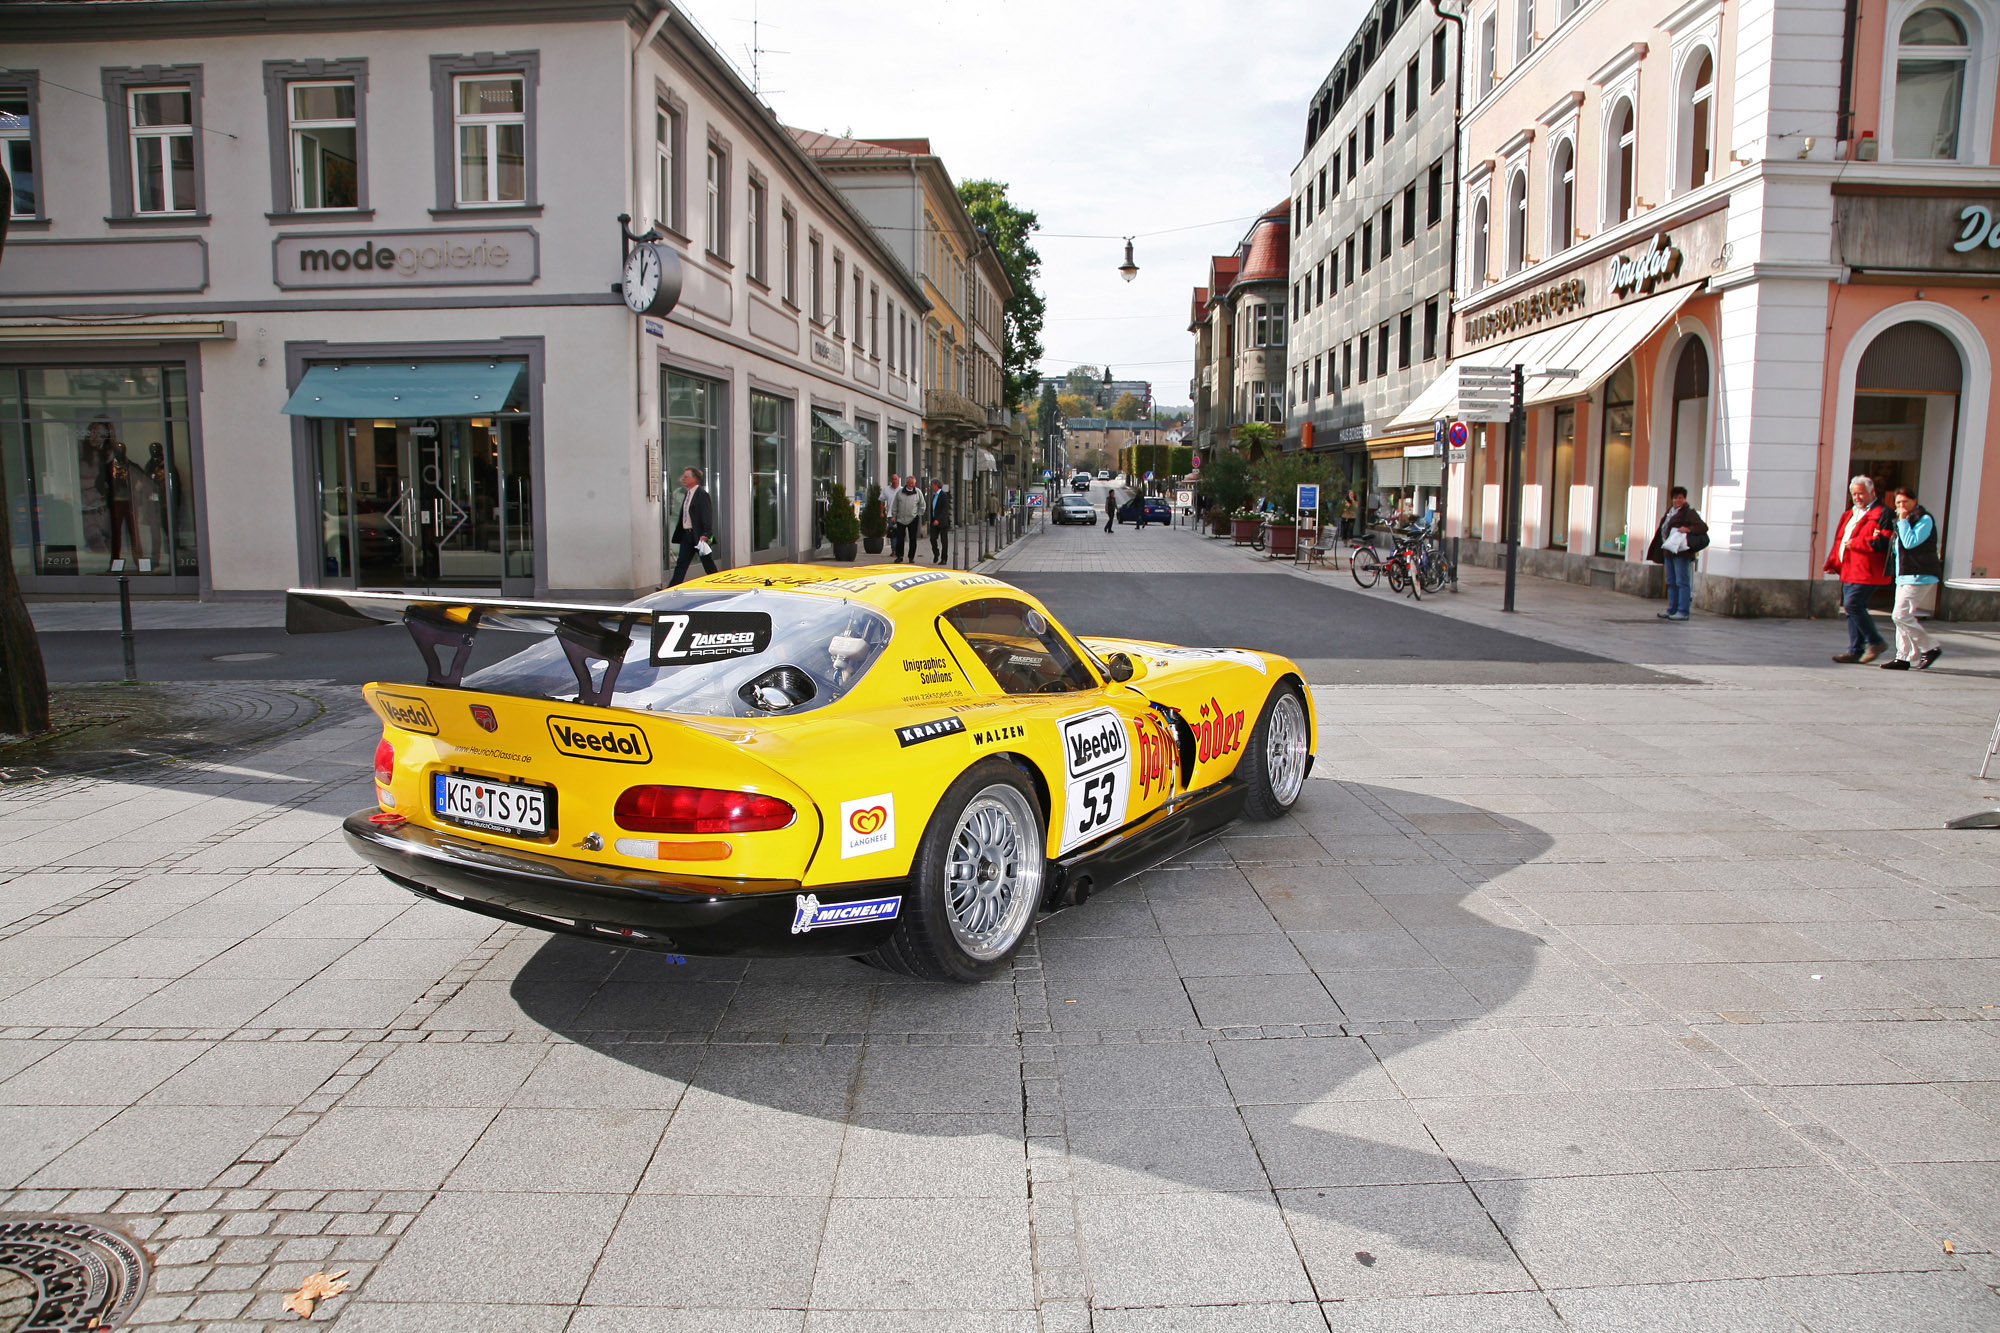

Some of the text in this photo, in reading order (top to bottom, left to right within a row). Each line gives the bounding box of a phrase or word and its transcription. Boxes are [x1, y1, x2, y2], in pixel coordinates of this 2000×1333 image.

[1607, 231, 1674, 294] Douglas
[1464, 278, 1583, 344] HAUS BOXBERGER
[47, 556, 71, 565] zero
[895, 571, 946, 589] KRAFFT
[689, 646, 755, 657] RACING
[690, 631, 755, 649] ZAKSPEED
[902, 656, 947, 672] Unigraphics
[380, 699, 433, 728] Veedol
[552, 724, 642, 756] Veedol
[901, 718, 1025, 746] KRAFFT WALZEN
[1069, 721, 1122, 767] Veedol
[454, 744, 532, 764] www.HeurichClassics.de
[447, 781, 542, 826] KG TS 95
[1078, 771, 1116, 834] 53
[849, 833, 888, 848] LANGNESE
[817, 902, 897, 921] MICHELIN
